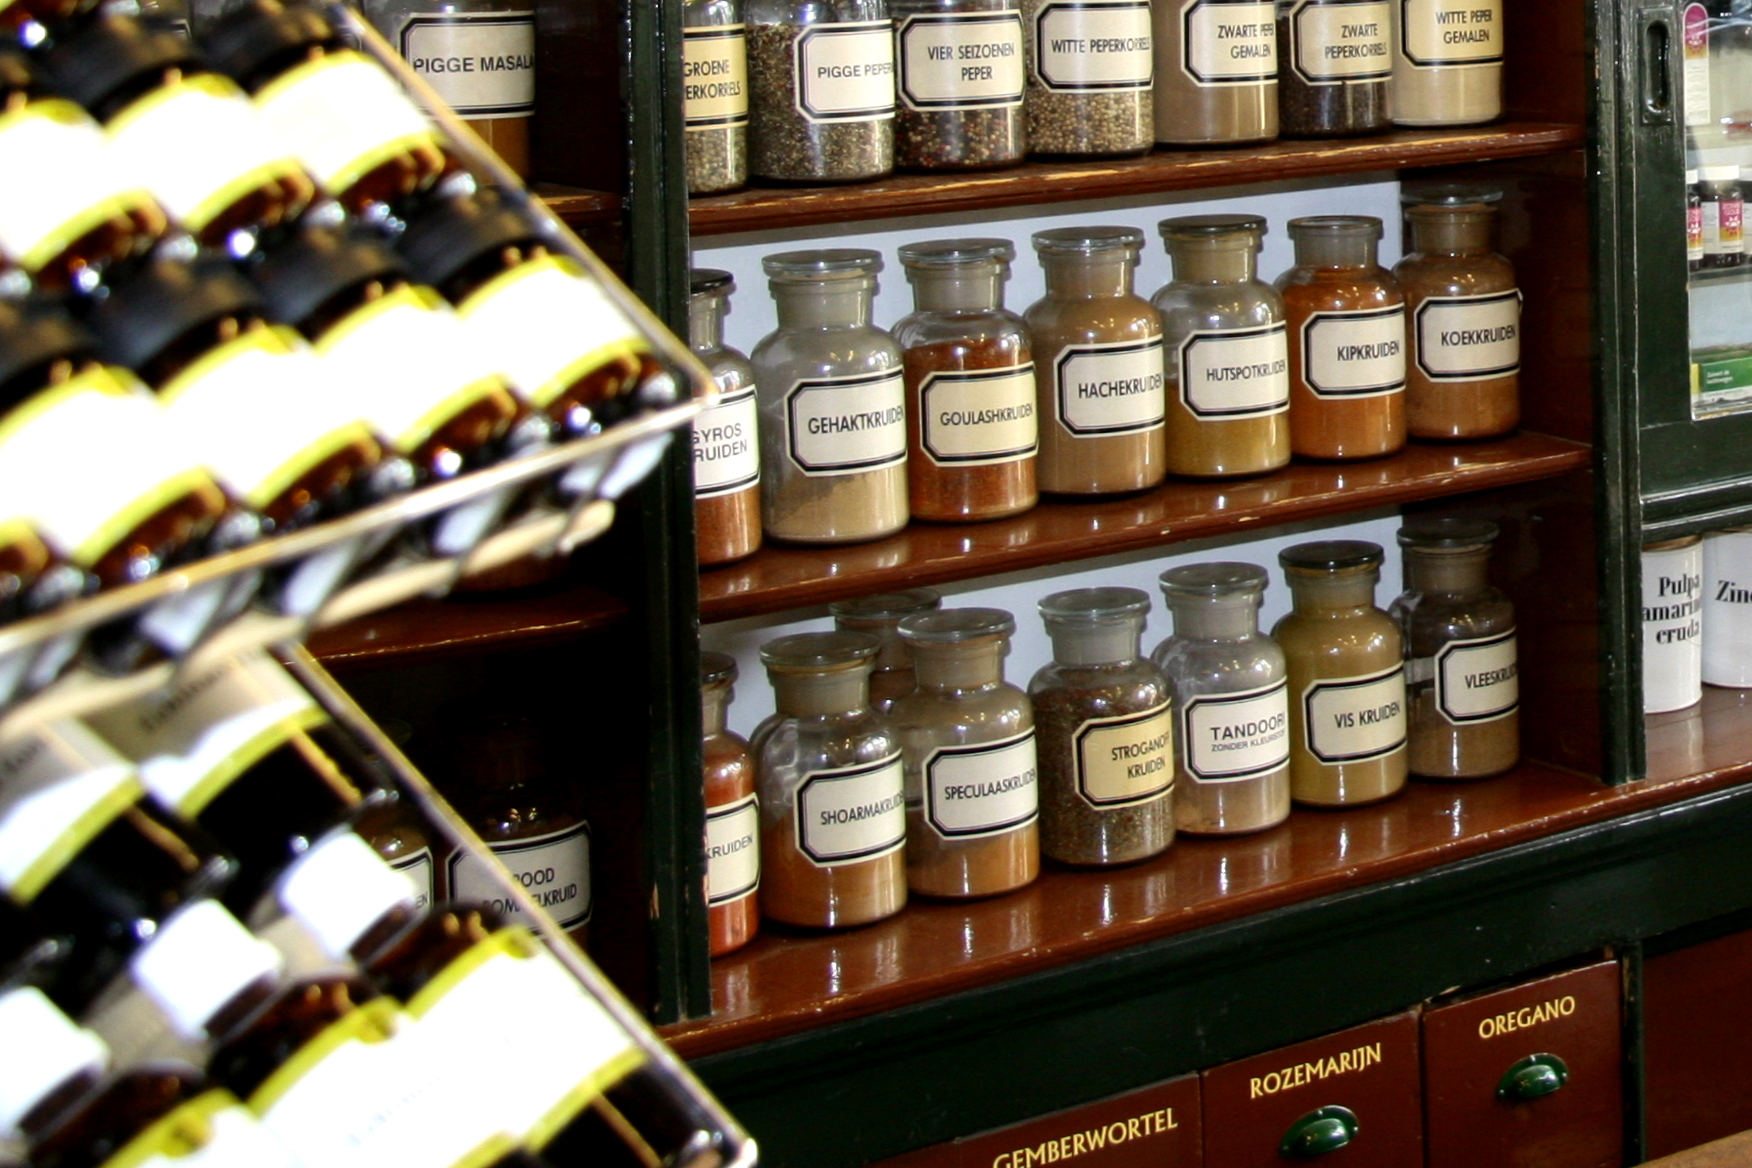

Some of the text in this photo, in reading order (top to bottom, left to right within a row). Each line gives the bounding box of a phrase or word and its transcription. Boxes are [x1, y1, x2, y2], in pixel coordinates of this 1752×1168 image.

[1435, 10, 1467, 25] WITTE
[1217, 24, 1258, 40] ZWARTE
[1341, 23, 1378, 40] ZWARTE
[1443, 28, 1490, 45] GEMALEN
[927, 42, 1015, 61] VIER SEIZOENEN
[1051, 38, 1086, 54] WITTE
[412, 56, 475, 73] PIGGE
[817, 64, 861, 79] PIGGE
[961, 65, 993, 82] PEPER
[1441, 323, 1517, 347] KOEKKRUIDEN
[1337, 340, 1400, 362] KIPKRUIDEN
[940, 403, 1033, 427] GOULASHKRUIDEN
[691, 421, 742, 447] GYROS
[1334, 700, 1401, 729] VIS KRUIDEN
[1211, 741, 1248, 752] ZONDER
[1127, 757, 1166, 779] KRUIDEN
[1478, 995, 1576, 1040] OREGANO
[1249, 1041, 1383, 1100] ROZEMARIJN
[992, 1106, 1179, 1168] GEMBERWORTEL
